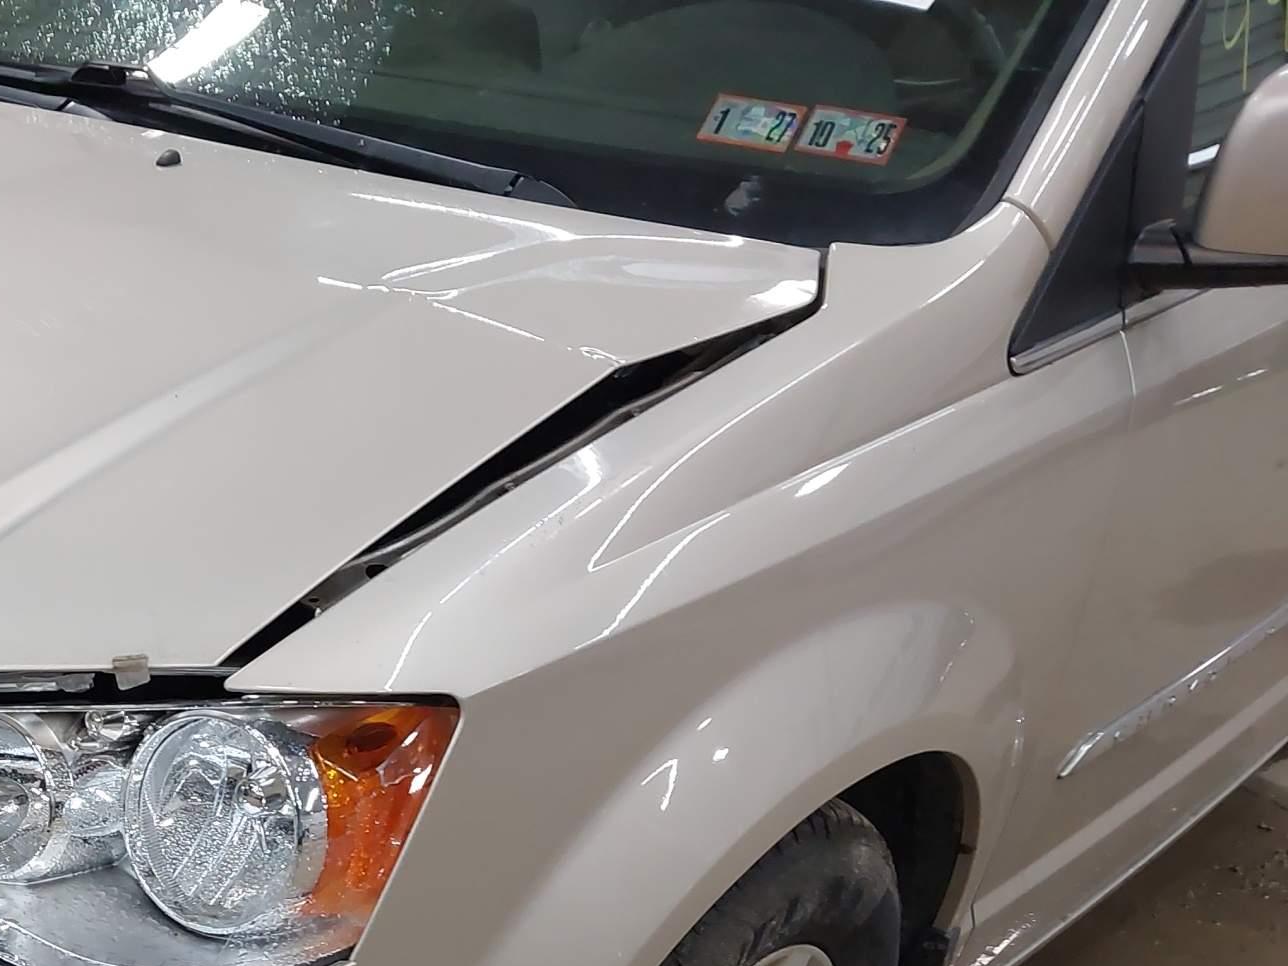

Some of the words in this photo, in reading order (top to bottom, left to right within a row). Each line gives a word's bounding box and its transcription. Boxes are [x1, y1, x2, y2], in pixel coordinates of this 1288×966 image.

[713, 106, 731, 135] 1
[765, 110, 797, 144] 27
[808, 120, 837, 149] 10
[864, 122, 897, 156] 25
